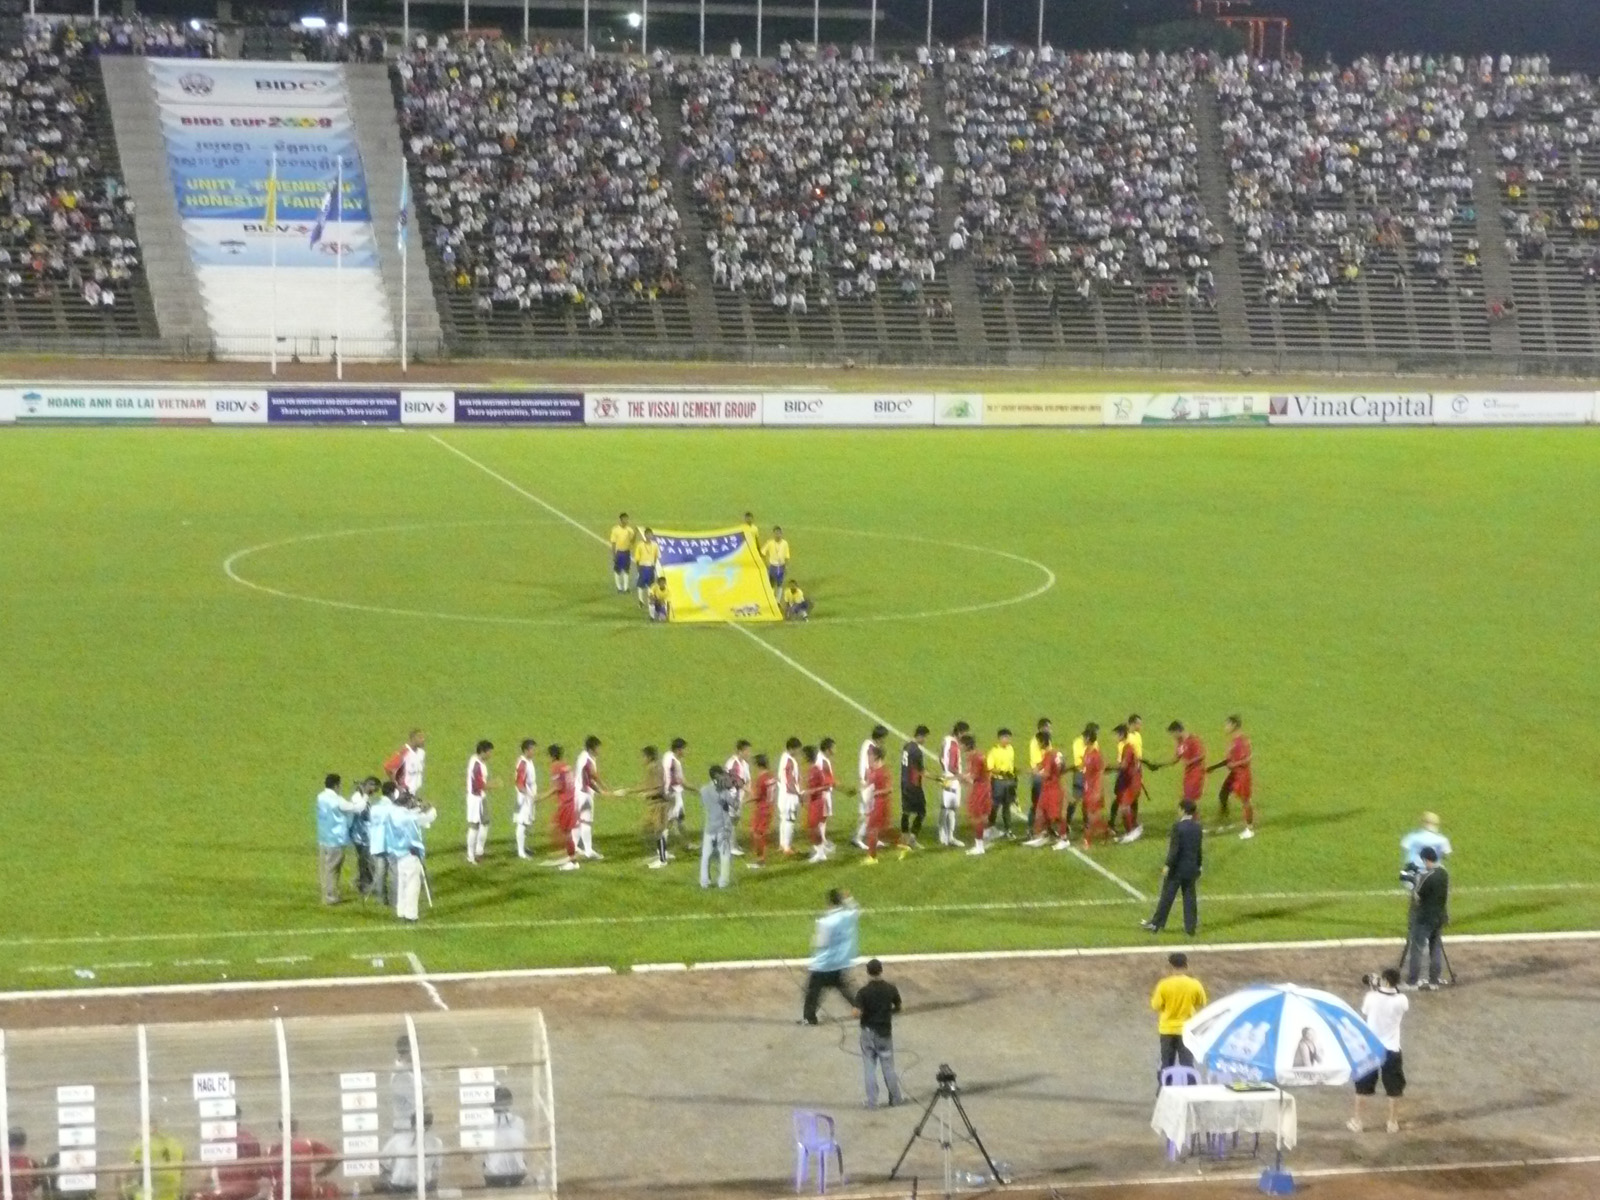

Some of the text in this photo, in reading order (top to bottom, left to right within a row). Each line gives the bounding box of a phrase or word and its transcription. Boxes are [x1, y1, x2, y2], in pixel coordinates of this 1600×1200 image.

[255, 79, 316, 91] BIDC
[181, 117, 225, 127] BIDC
[186, 178, 236, 190] UNITY
[186, 194, 266, 208] HONESTY
[243, 224, 290, 233] BIV
[47, 398, 207, 410] HOANG ANH GIA LAI VIETNAM
[216, 400, 247, 412] BIDV
[404, 402, 435, 413] BIDV
[784, 400, 820, 413] BIDC
[874, 400, 909, 413] BIDC
[1294, 393, 1434, 423] VinaCapital
[281, 407, 299, 416] Share
[346, 407, 364, 416] Share
[365, 407, 388, 416] success
[467, 408, 485, 417] Share
[530, 408, 548, 417] Share
[549, 408, 571, 417] success
[628, 402, 757, 419] THE VISSAI CEMENT GROUP
[656, 537, 675, 545] MY
[724, 535, 738, 544] IS
[660, 542, 739, 555] FAIR PLAY
[197, 1077, 227, 1092] HAGL FC
